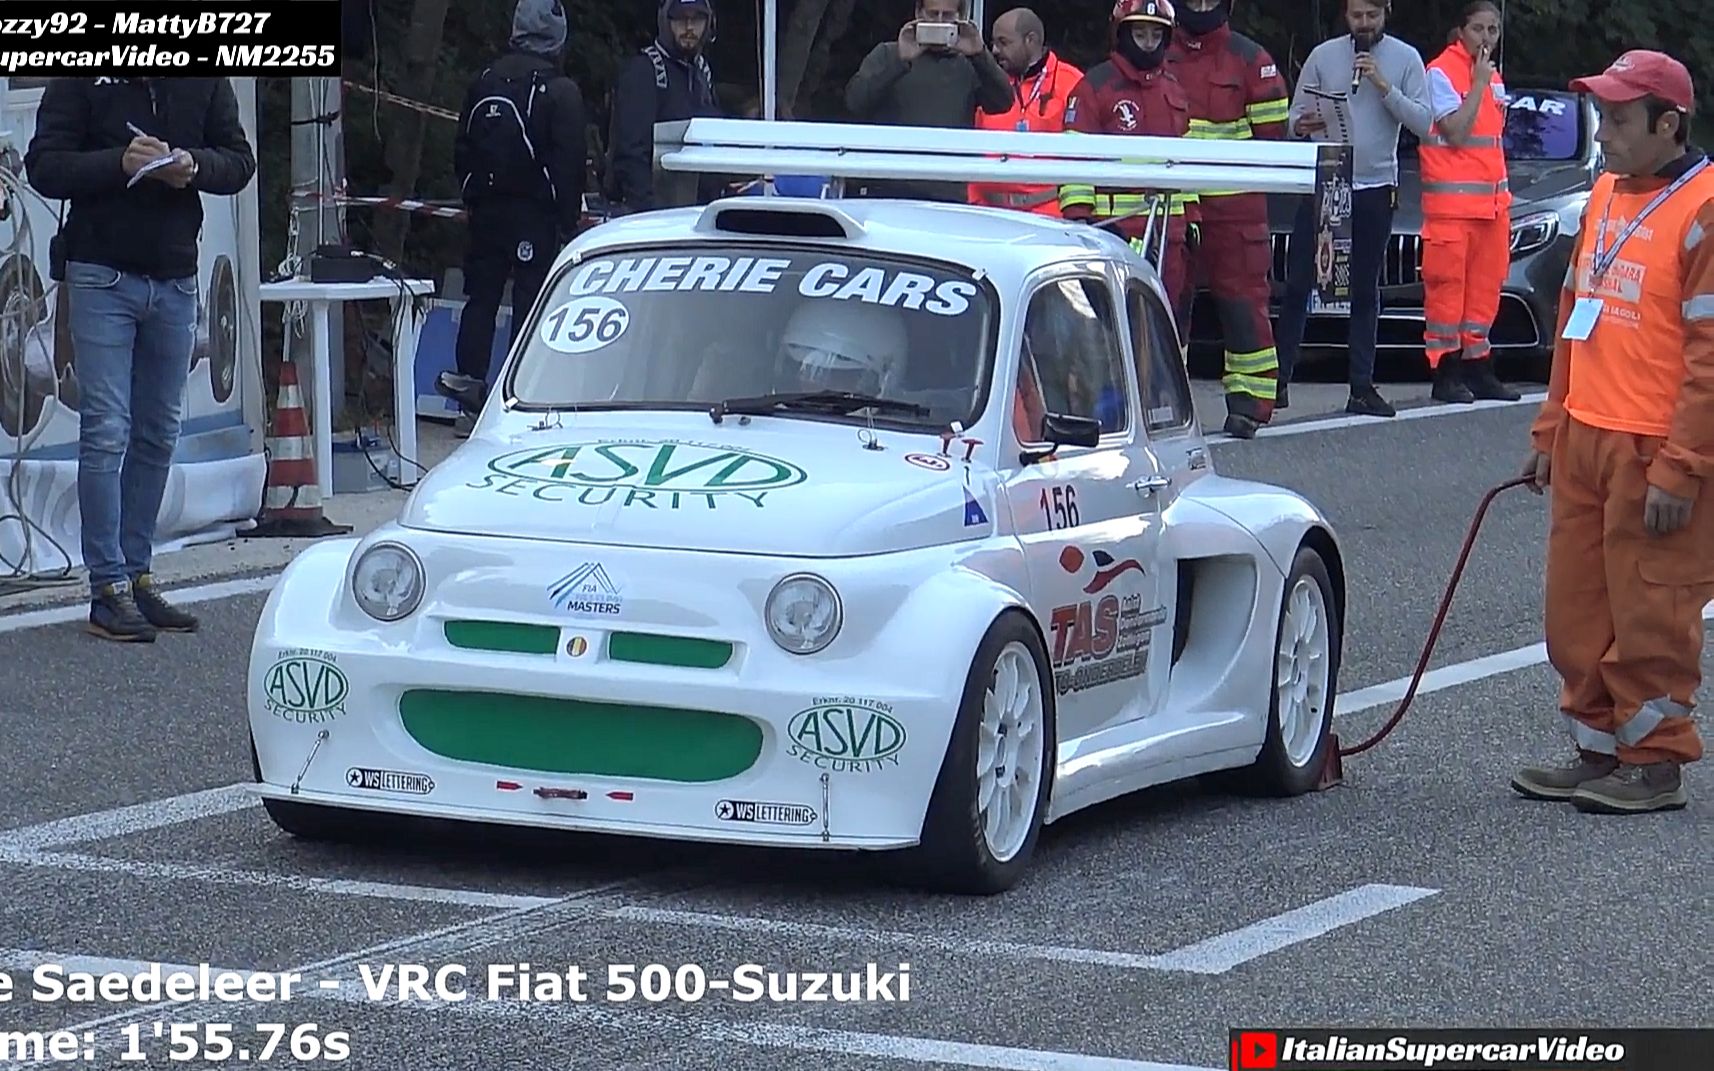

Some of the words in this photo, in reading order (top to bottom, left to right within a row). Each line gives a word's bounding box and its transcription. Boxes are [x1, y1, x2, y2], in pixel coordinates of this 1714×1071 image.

[569, 257, 791, 296] CHERIE
[798, 263, 977, 315] CARS
[549, 308, 626, 342] 156
[507, 444, 792, 487] ASVD
[466, 474, 768, 509] SECURITY
[1040, 485, 1079, 531] 156
[567, 601, 621, 614] MASTERS
[582, 584, 597, 593] FIA
[1051, 594, 1119, 667] TAS
[270, 661, 344, 709] ASVD
[264, 699, 347, 724] SECURITY
[797, 708, 900, 757] ASVD
[786, 744, 900, 772] SECURITY
